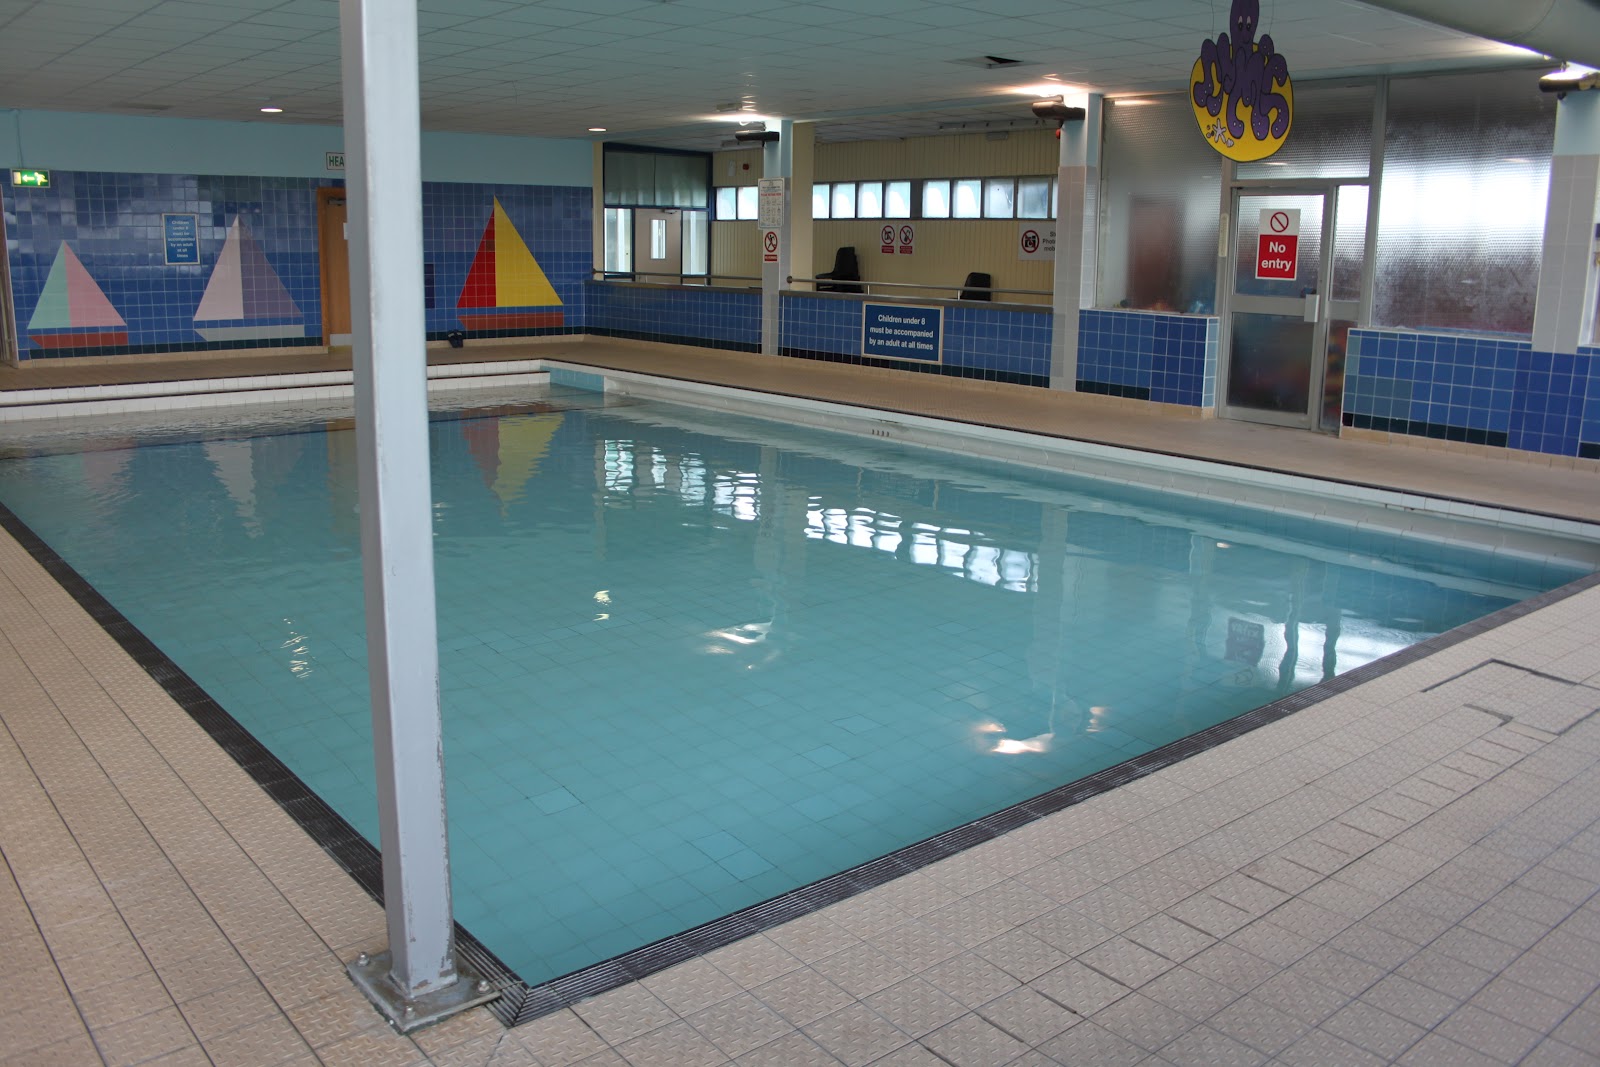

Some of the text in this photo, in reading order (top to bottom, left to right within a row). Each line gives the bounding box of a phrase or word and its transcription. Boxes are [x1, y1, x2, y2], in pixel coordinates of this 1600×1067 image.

[1269, 242, 1286, 253] No
[1261, 258, 1292, 272] entry
[878, 314, 926, 325] Children under 8
[869, 326, 934, 338] must be accompanied
[869, 337, 876, 346] by
[885, 339, 900, 348] adult
[916, 342, 933, 351] times
